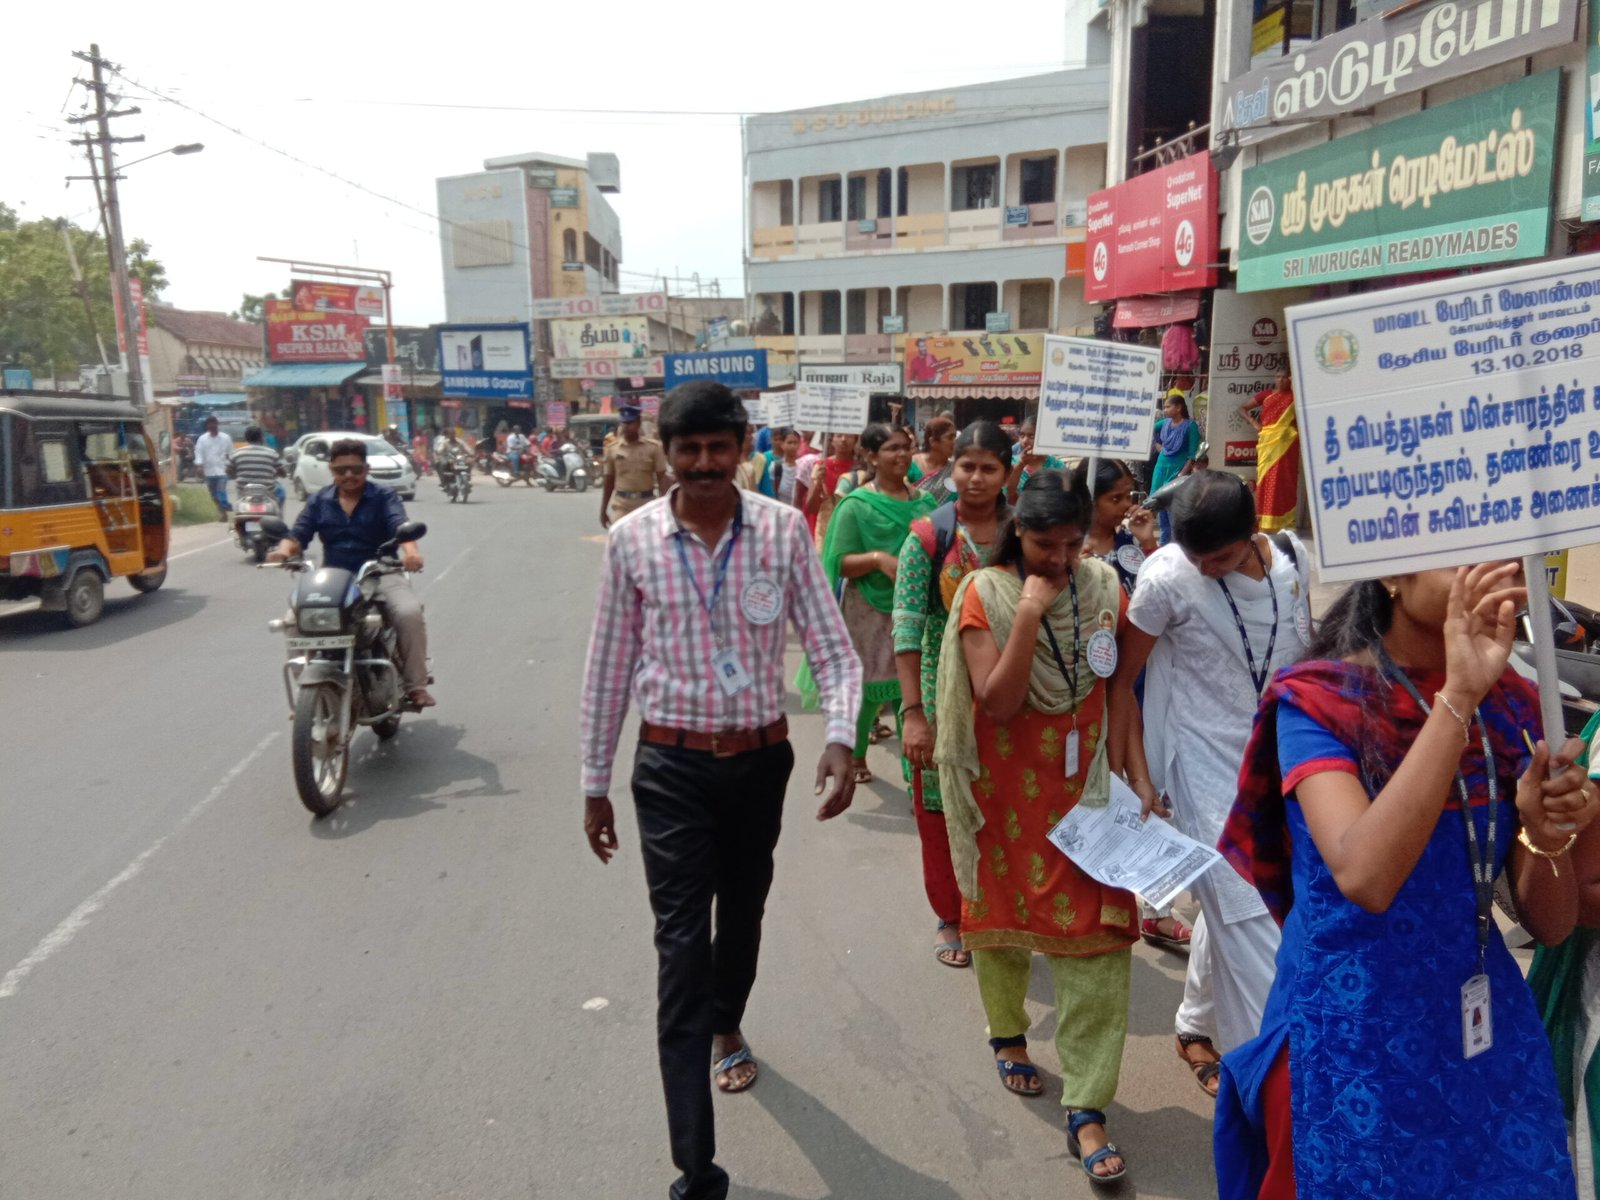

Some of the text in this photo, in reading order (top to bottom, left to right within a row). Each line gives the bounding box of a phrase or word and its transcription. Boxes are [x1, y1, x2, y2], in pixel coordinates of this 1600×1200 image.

[1166, 186, 1202, 209] SuperNet
[1309, 149, 1387, 233] முருகன்
[1176, 227, 1193, 256] 4G
[1283, 223, 1519, 278] SRI MURUGAN READYMADES
[1094, 247, 1106, 272] 4G
[1435, 292, 1493, 323] பேரிடர்
[290, 323, 348, 342] KSM
[580, 323, 620, 348] தீபம்
[277, 343, 314, 354] SUPER
[1377, 346, 1447, 372] தேசிய
[1453, 330, 1522, 356] பேரிடர்
[1471, 343, 1583, 375] 13.10.2018
[674, 354, 755, 377] SAMSUNG
[444, 377, 526, 392] SAMSUNG Galaxy
[862, 372, 895, 385] Raja
[1325, 415, 1341, 464] தீ
[1347, 401, 1454, 458] விபத்துகள்
[1460, 378, 1586, 433] மின்சாரத்தின்
[1486, 429, 1582, 487] தண்ணீரை
[1347, 502, 1420, 545] மெயின்
[1428, 492, 1523, 534] சுவிட்ச்சை
[1488, 779, 1496, 800] NGMC
[1488, 822, 1496, 842] NGMC
[1474, 863, 1482, 883] NGMC
[1484, 863, 1493, 883] NGMC
